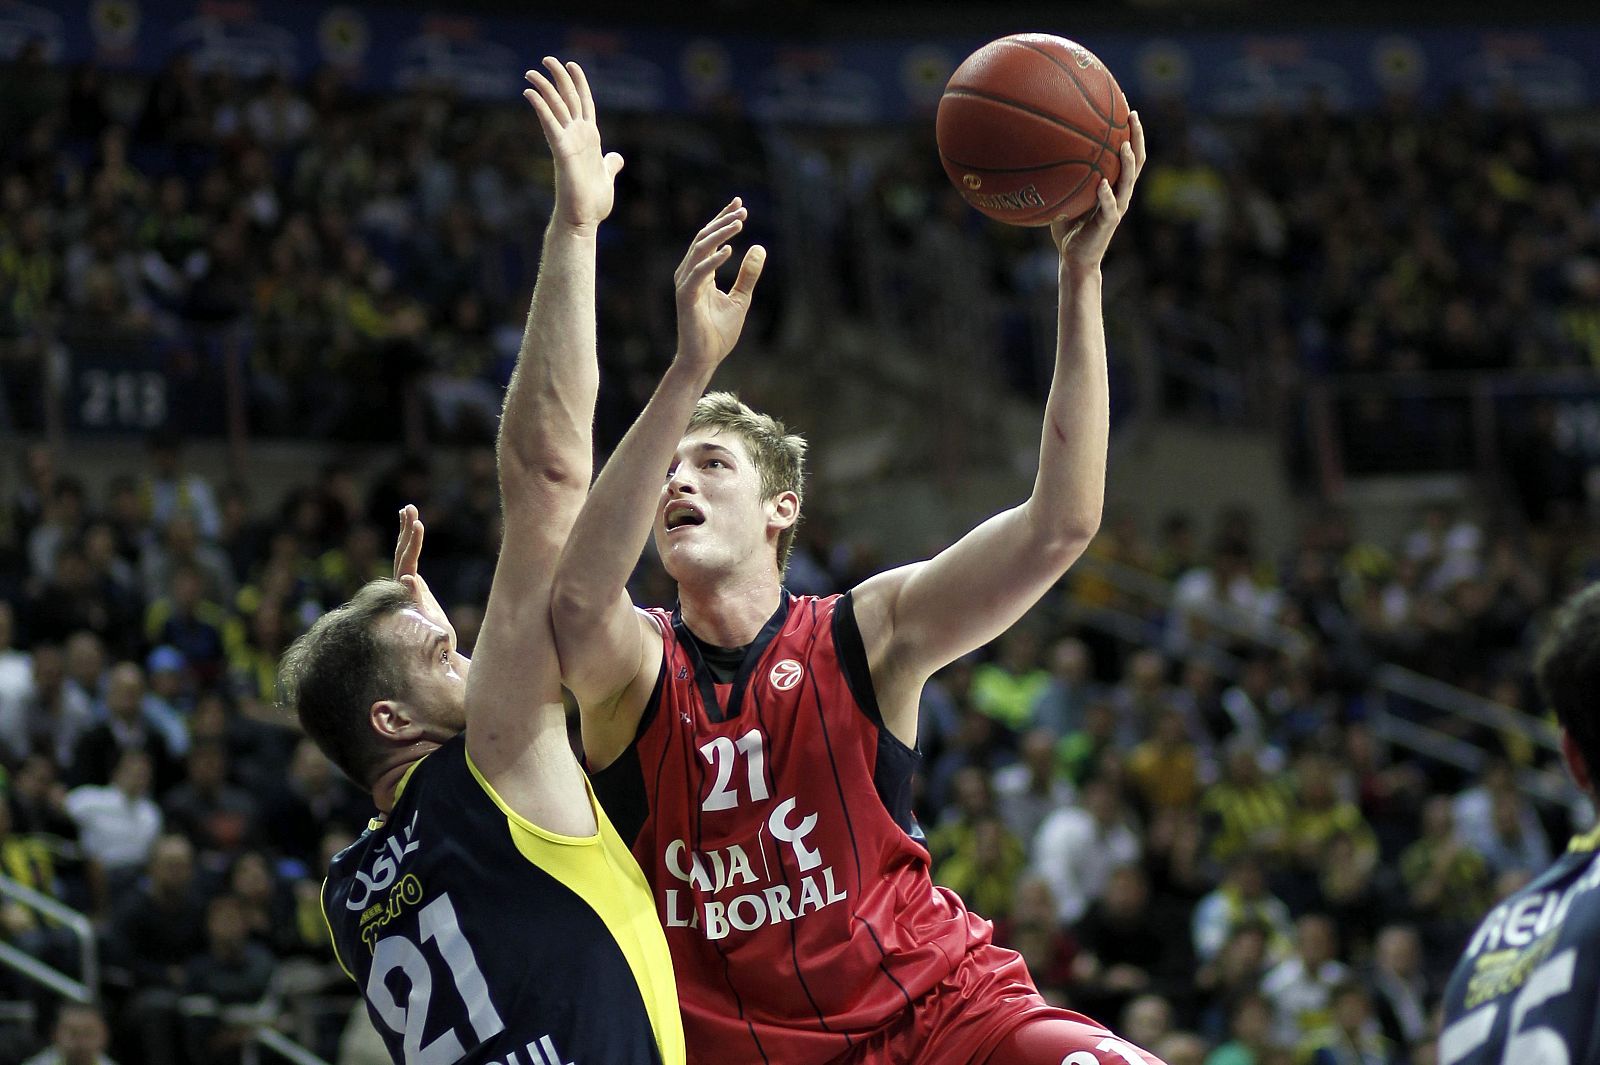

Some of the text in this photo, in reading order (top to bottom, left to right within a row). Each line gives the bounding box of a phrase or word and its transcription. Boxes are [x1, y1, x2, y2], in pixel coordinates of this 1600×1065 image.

[699, 728, 770, 812] 21
[665, 839, 759, 894] CAJA
[665, 866, 847, 940] LBORAL
[366, 891, 506, 1065] 21
